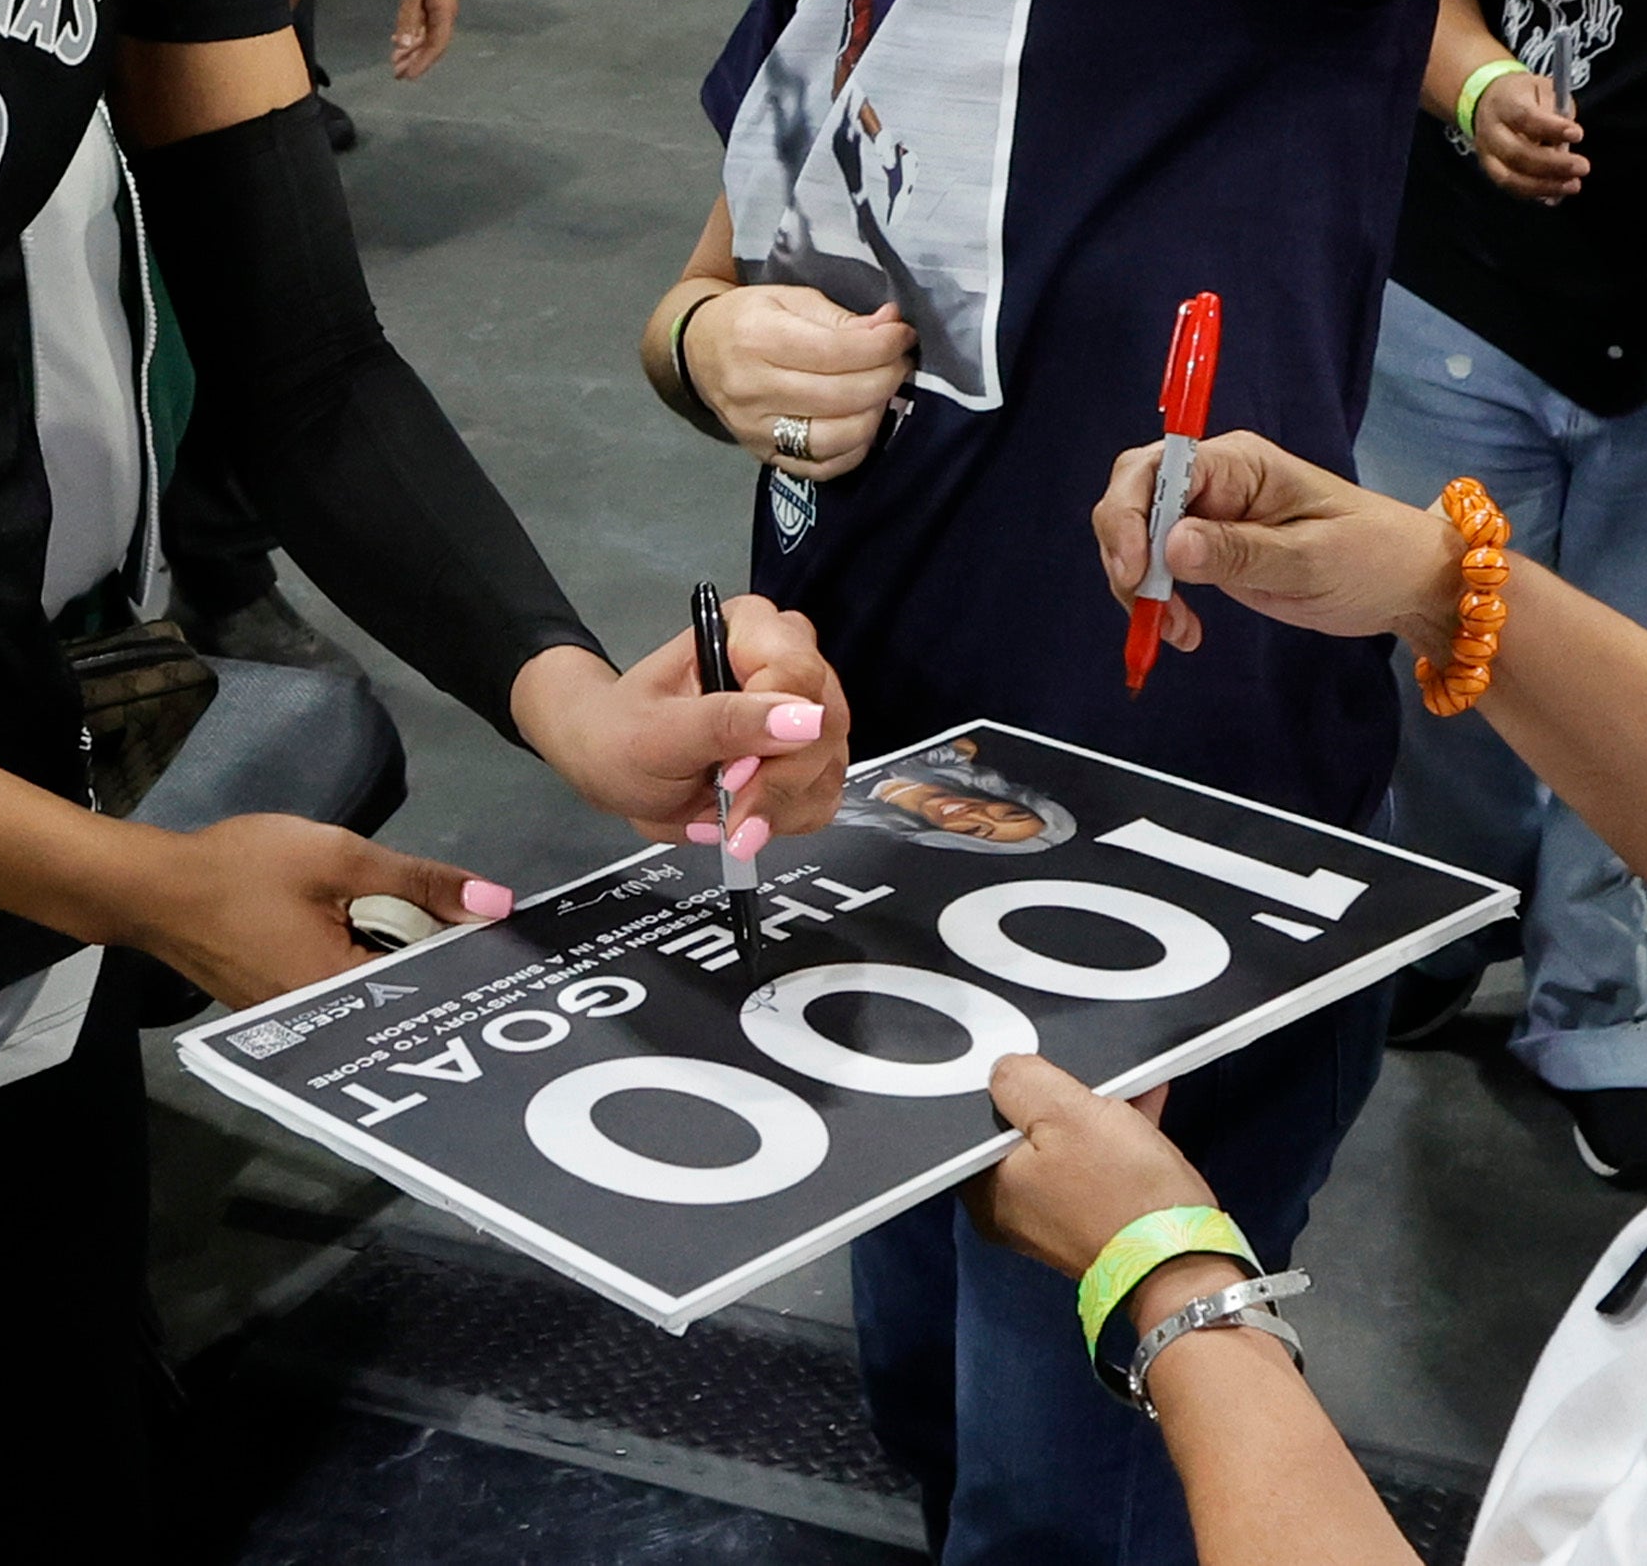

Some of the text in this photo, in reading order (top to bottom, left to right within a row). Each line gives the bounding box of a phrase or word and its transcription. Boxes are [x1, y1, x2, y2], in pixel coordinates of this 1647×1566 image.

[594, 907, 675, 946] POINTS
[657, 876, 896, 972] THE
[545, 953, 566, 966] A
[567, 941, 596, 958] IN
[306, 863, 822, 1091] THE PERSON IN WNBA HISTORY TO SCORE
[461, 964, 546, 1003] SINGLE
[295, 996, 366, 1036] ACES
[365, 999, 462, 1046] SEASON
[340, 975, 647, 1128] GOAT
